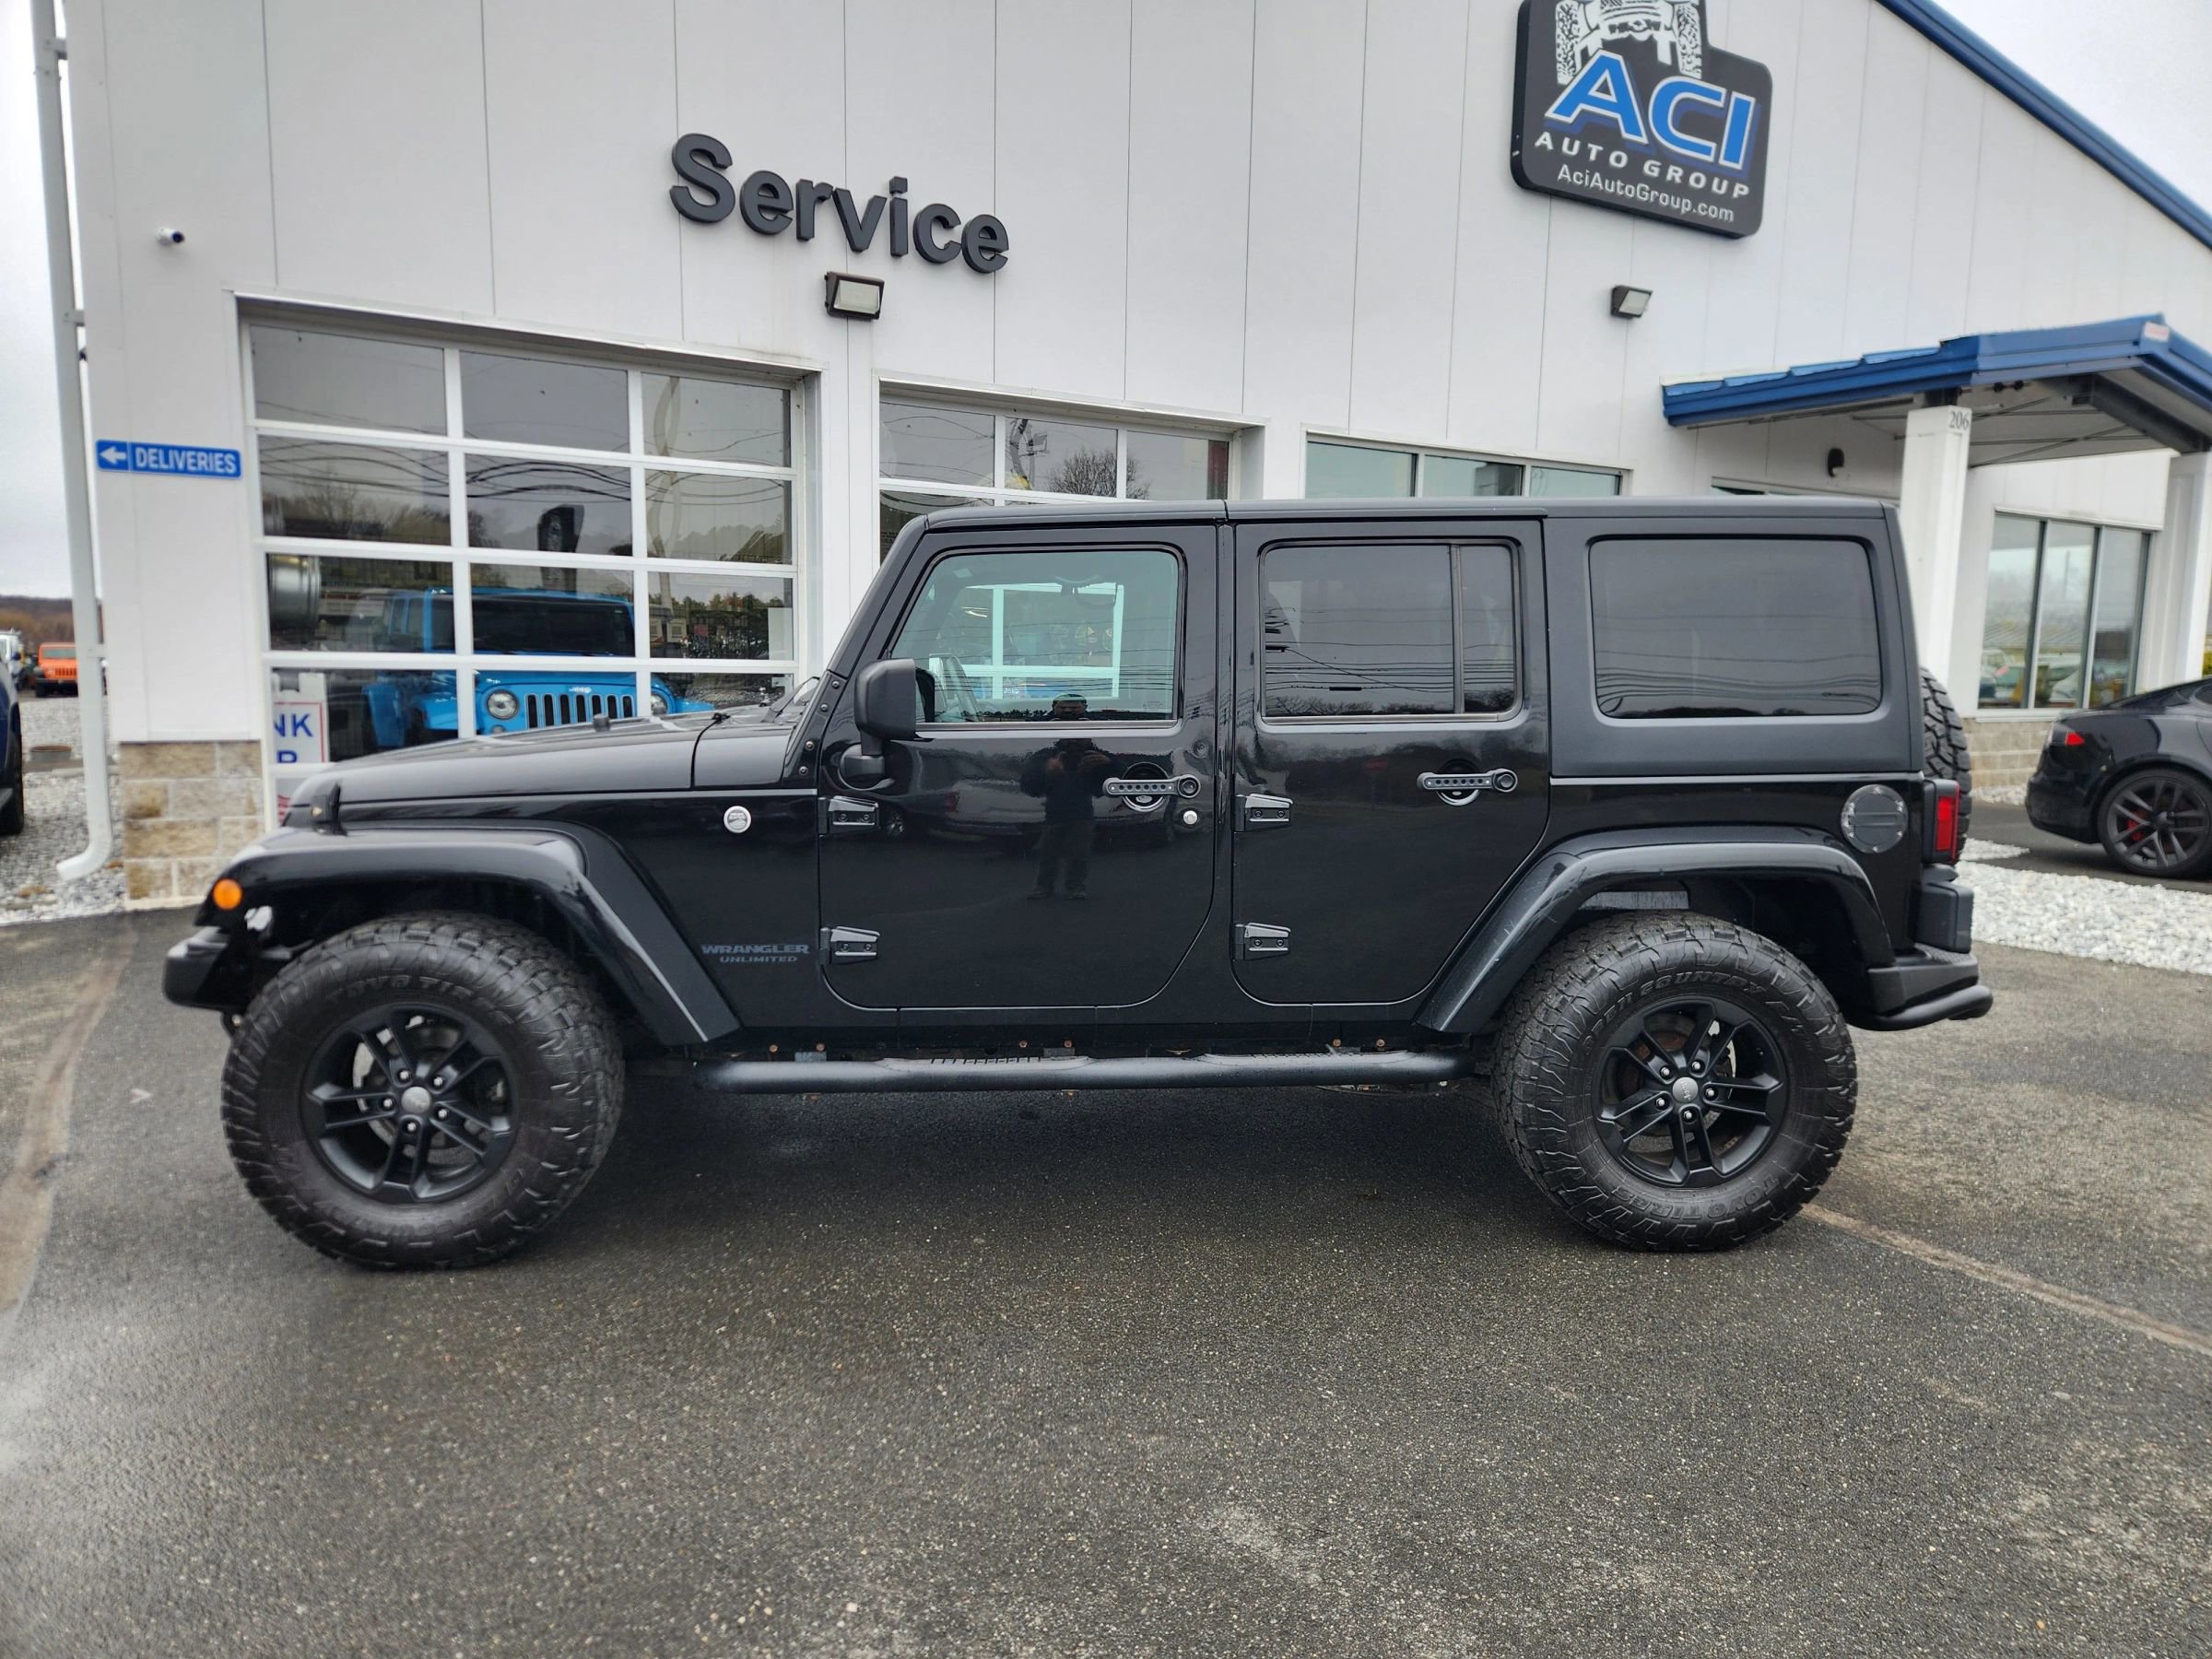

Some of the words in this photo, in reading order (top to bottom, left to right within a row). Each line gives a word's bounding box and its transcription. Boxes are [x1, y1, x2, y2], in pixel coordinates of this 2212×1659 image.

[1545, 49, 1757, 171] ACI
[1535, 131, 1628, 169] AUTO
[1643, 159, 1750, 200] GROUP
[1558, 164, 1735, 223] AciAutoGroup.com
[669, 133, 1009, 274] Service
[1948, 411, 1970, 430] 206
[135, 447, 237, 474] DELIVERIES
[700, 944, 809, 955] WRANGLER
